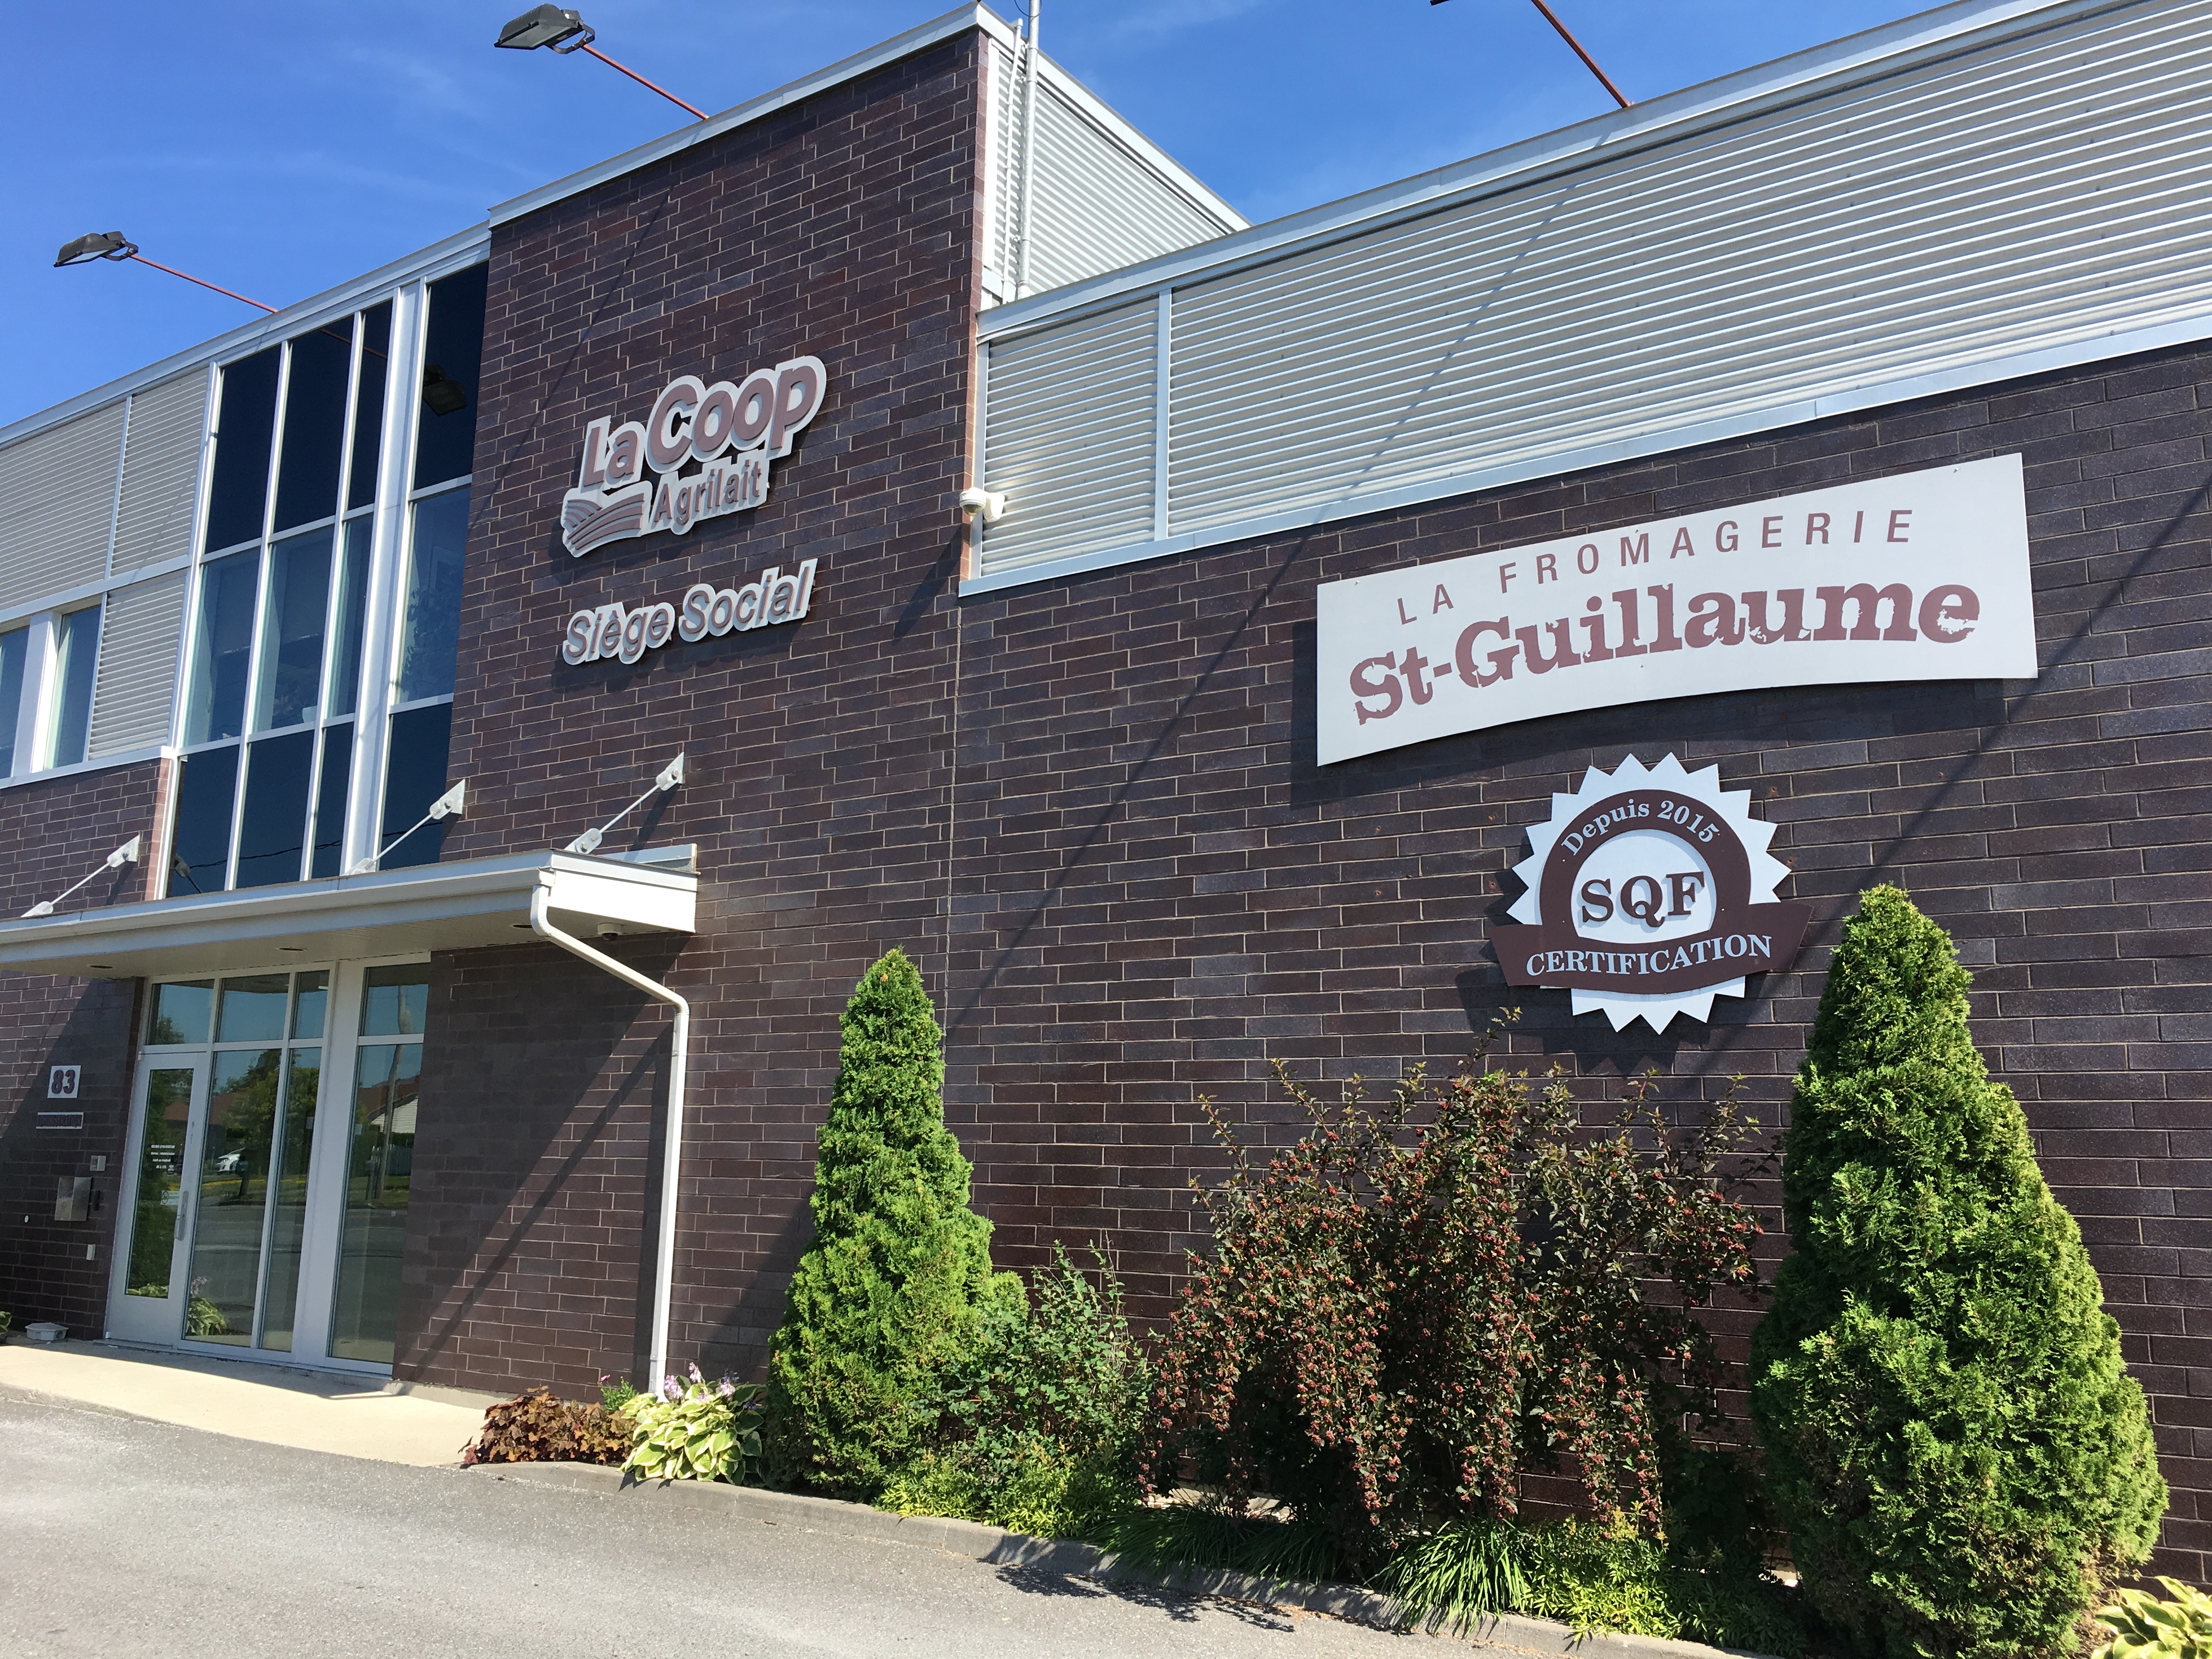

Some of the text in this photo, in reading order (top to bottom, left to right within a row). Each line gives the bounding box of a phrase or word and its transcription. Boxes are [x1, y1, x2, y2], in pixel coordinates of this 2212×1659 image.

[583, 365, 817, 488] La Coop
[653, 460, 761, 524] Agrilait
[1397, 509, 1914, 625] LA FROMAGERIE
[566, 566, 810, 658] Siège Social
[1349, 582, 1981, 725] St-Guillaume
[1561, 799, 1720, 856] Depuis 2015
[1581, 871, 1705, 927] SQF
[1526, 934, 1772, 976] CERTIFICATION
[52, 1070, 75, 1094] 83
